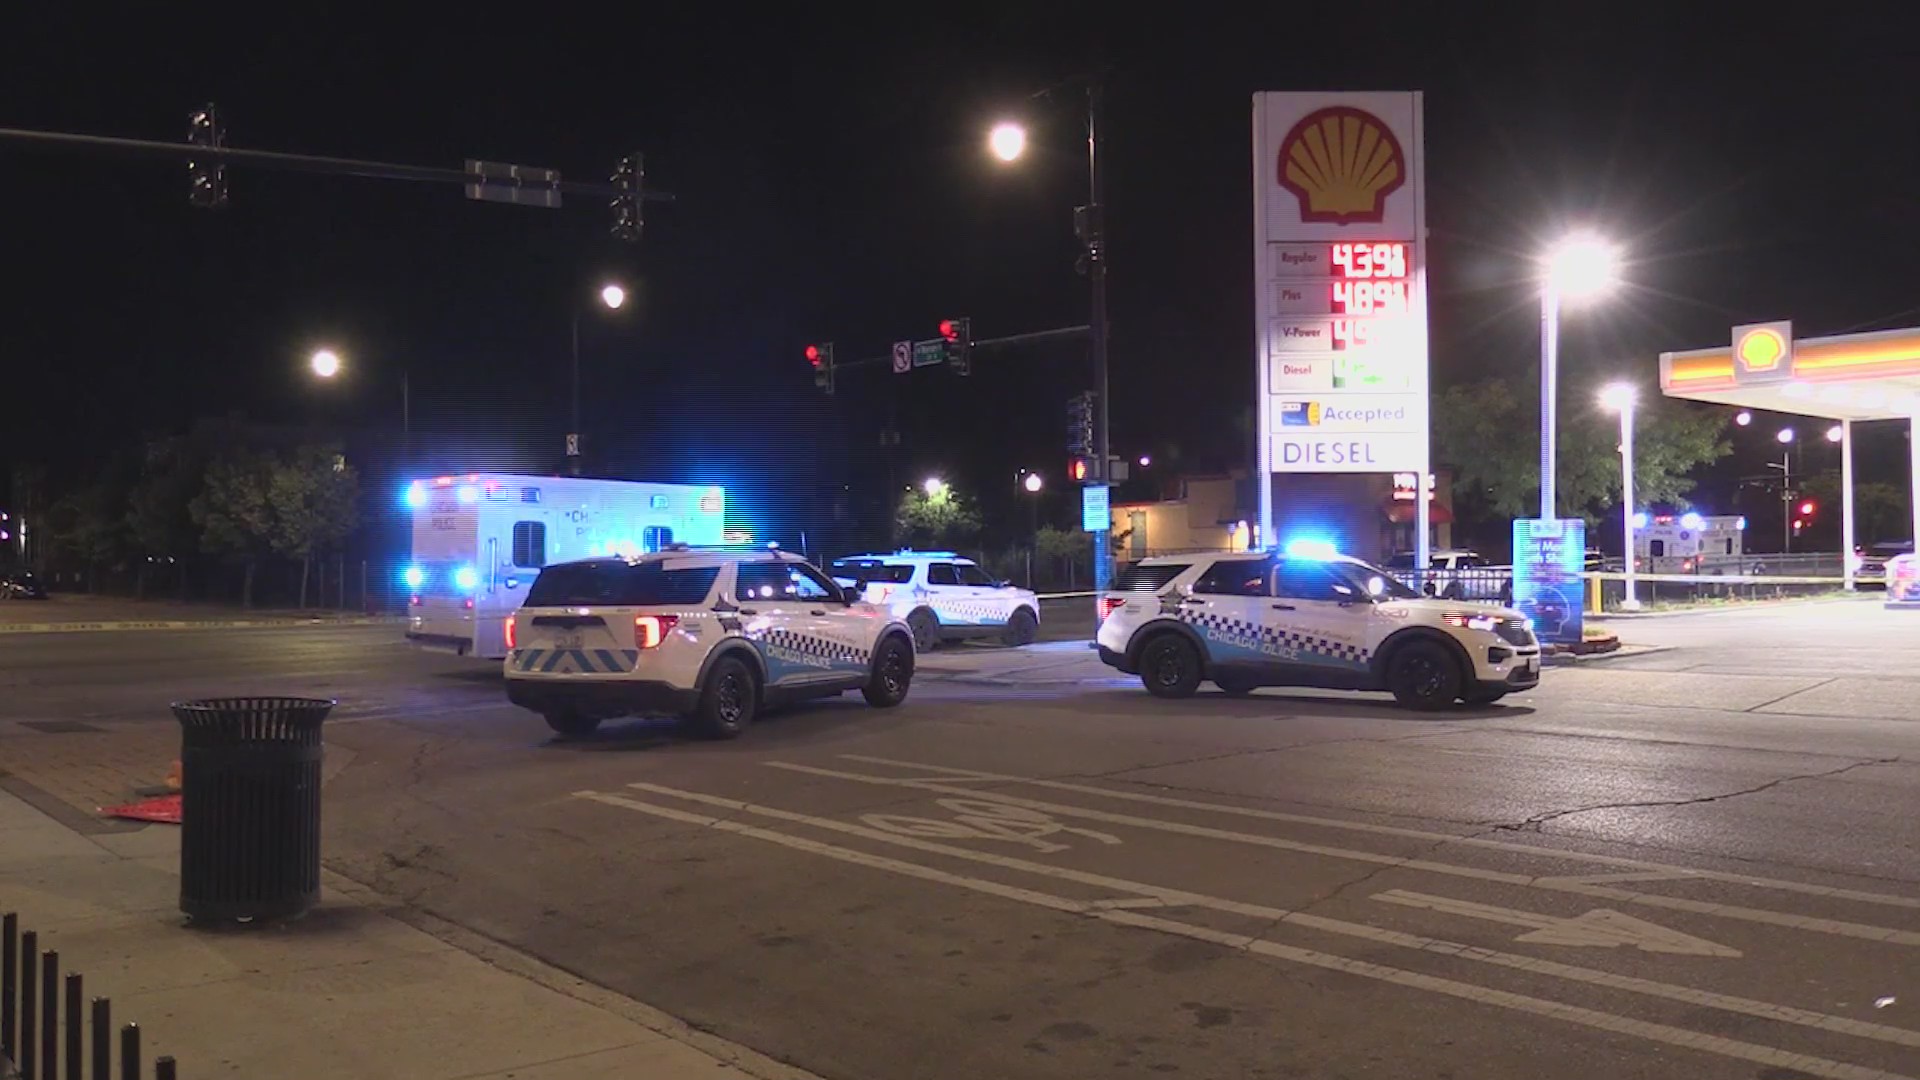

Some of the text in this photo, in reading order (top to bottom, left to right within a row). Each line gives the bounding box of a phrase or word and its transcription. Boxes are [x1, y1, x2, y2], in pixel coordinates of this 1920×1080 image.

[1282, 252, 1317, 264] Regular
[1282, 289, 1301, 300] Plus
[1283, 327, 1321, 337] V-Power
[1283, 364, 1312, 374] Diesel
[1324, 406, 1405, 422] Accepted
[1283, 442, 1376, 464] DIESEL
[1207, 629, 1299, 661] CHICAGO OLICE
[766, 644, 832, 670] CHICAGO POLICE
